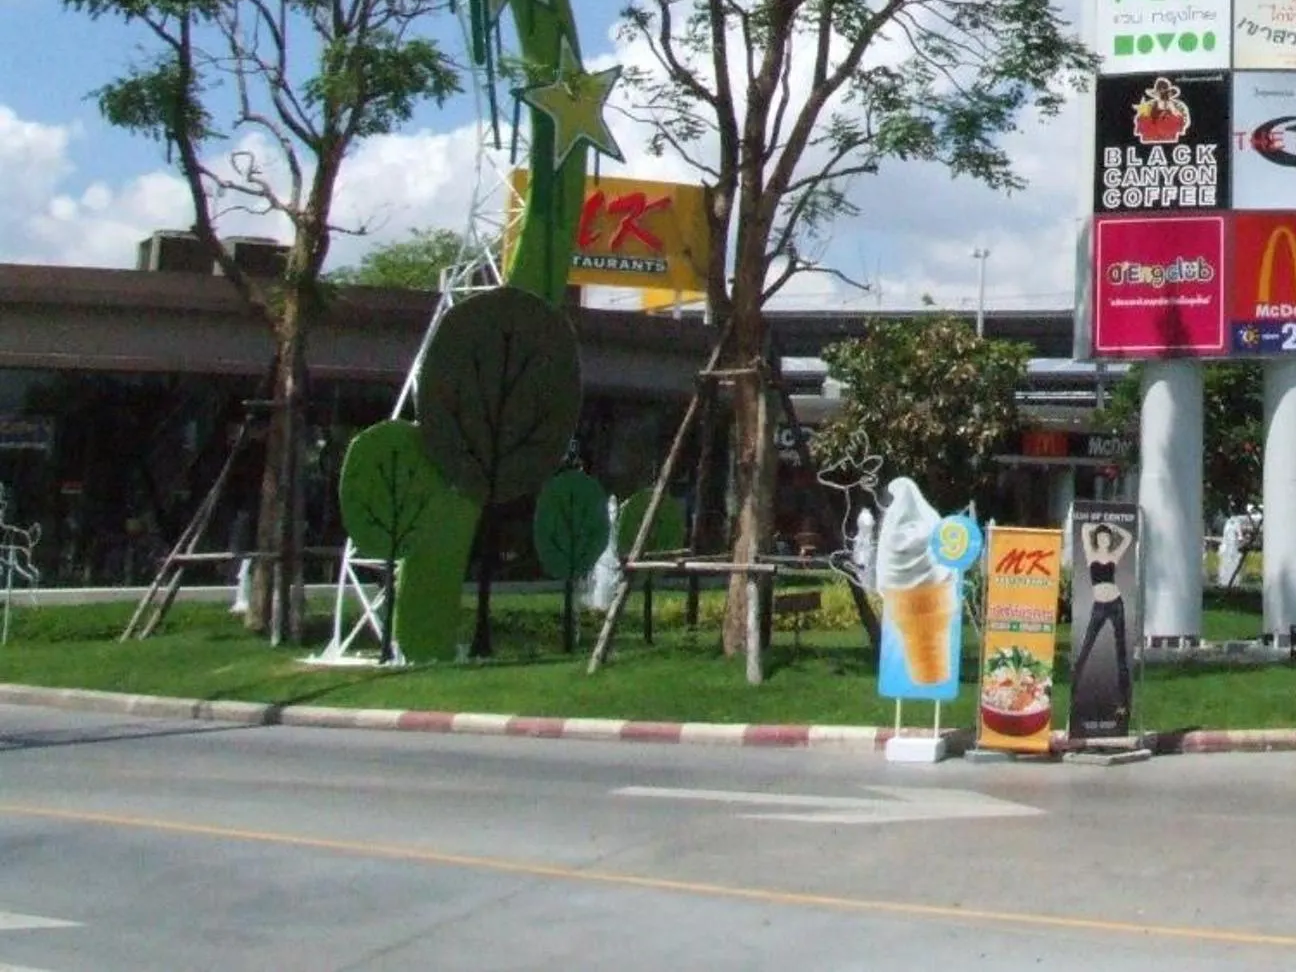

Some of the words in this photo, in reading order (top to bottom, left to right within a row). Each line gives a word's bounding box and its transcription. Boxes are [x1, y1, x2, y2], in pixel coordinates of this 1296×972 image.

[1103, 144, 1218, 168] BLACK
[1103, 166, 1218, 187] CANYON
[1102, 186, 1217, 208] COFFEE
[572, 255, 667, 273] TAURANTS
[938, 521, 969, 560] 9
[995, 548, 1055, 576] MK
